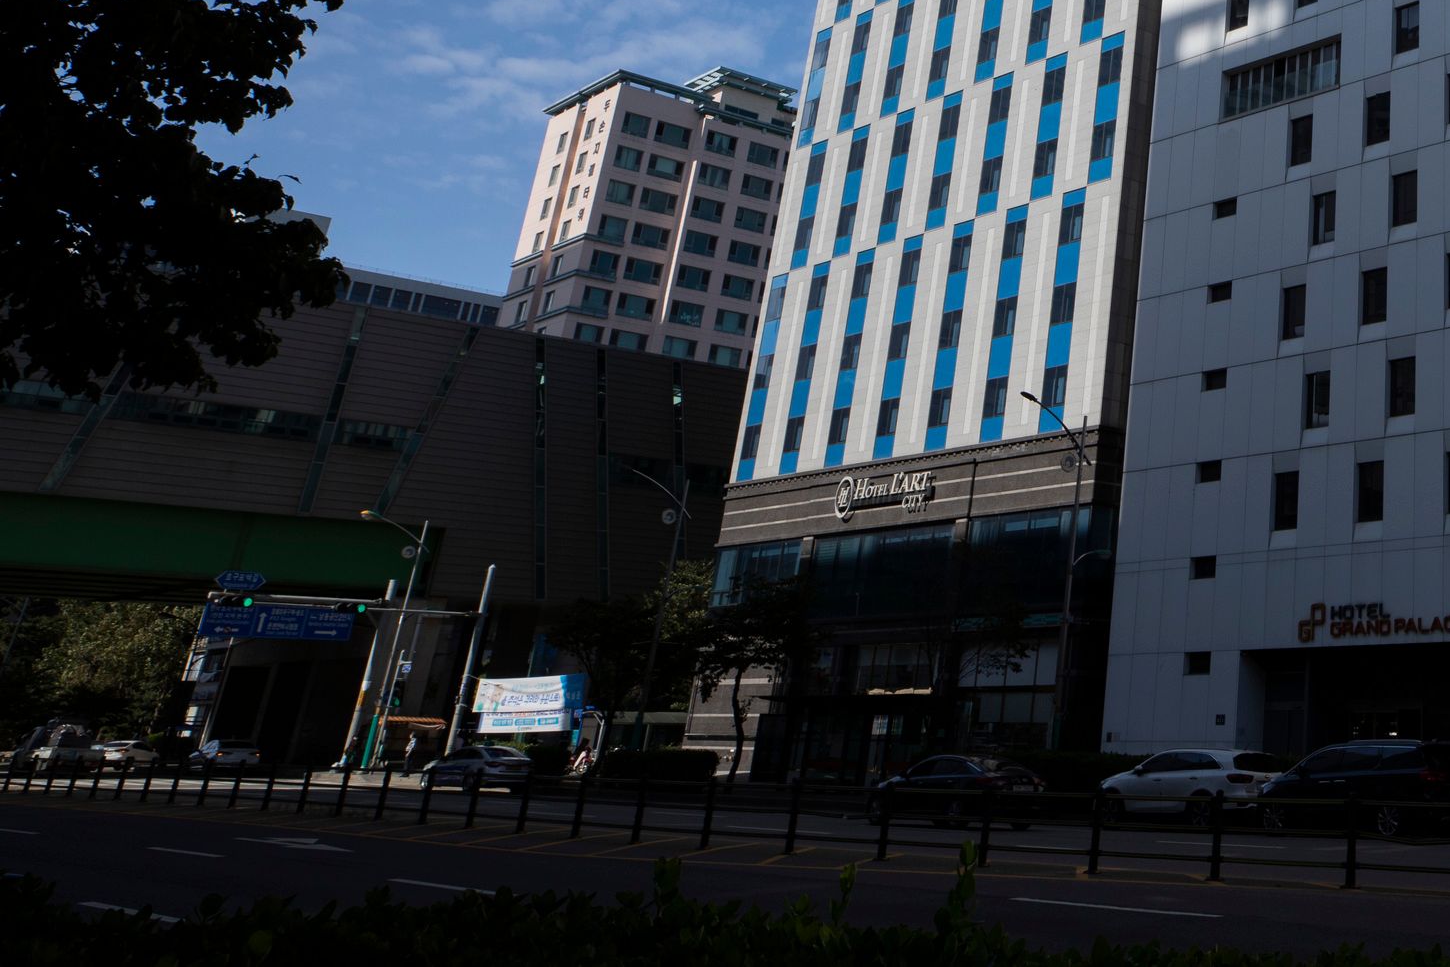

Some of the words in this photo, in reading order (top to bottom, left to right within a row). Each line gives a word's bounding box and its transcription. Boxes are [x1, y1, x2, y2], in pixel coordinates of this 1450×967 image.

[889, 471, 932, 495] L'ART
[901, 493, 926, 509] CITY
[1330, 603, 1391, 621] HOTEL
[1330, 617, 1391, 638] GRAND
